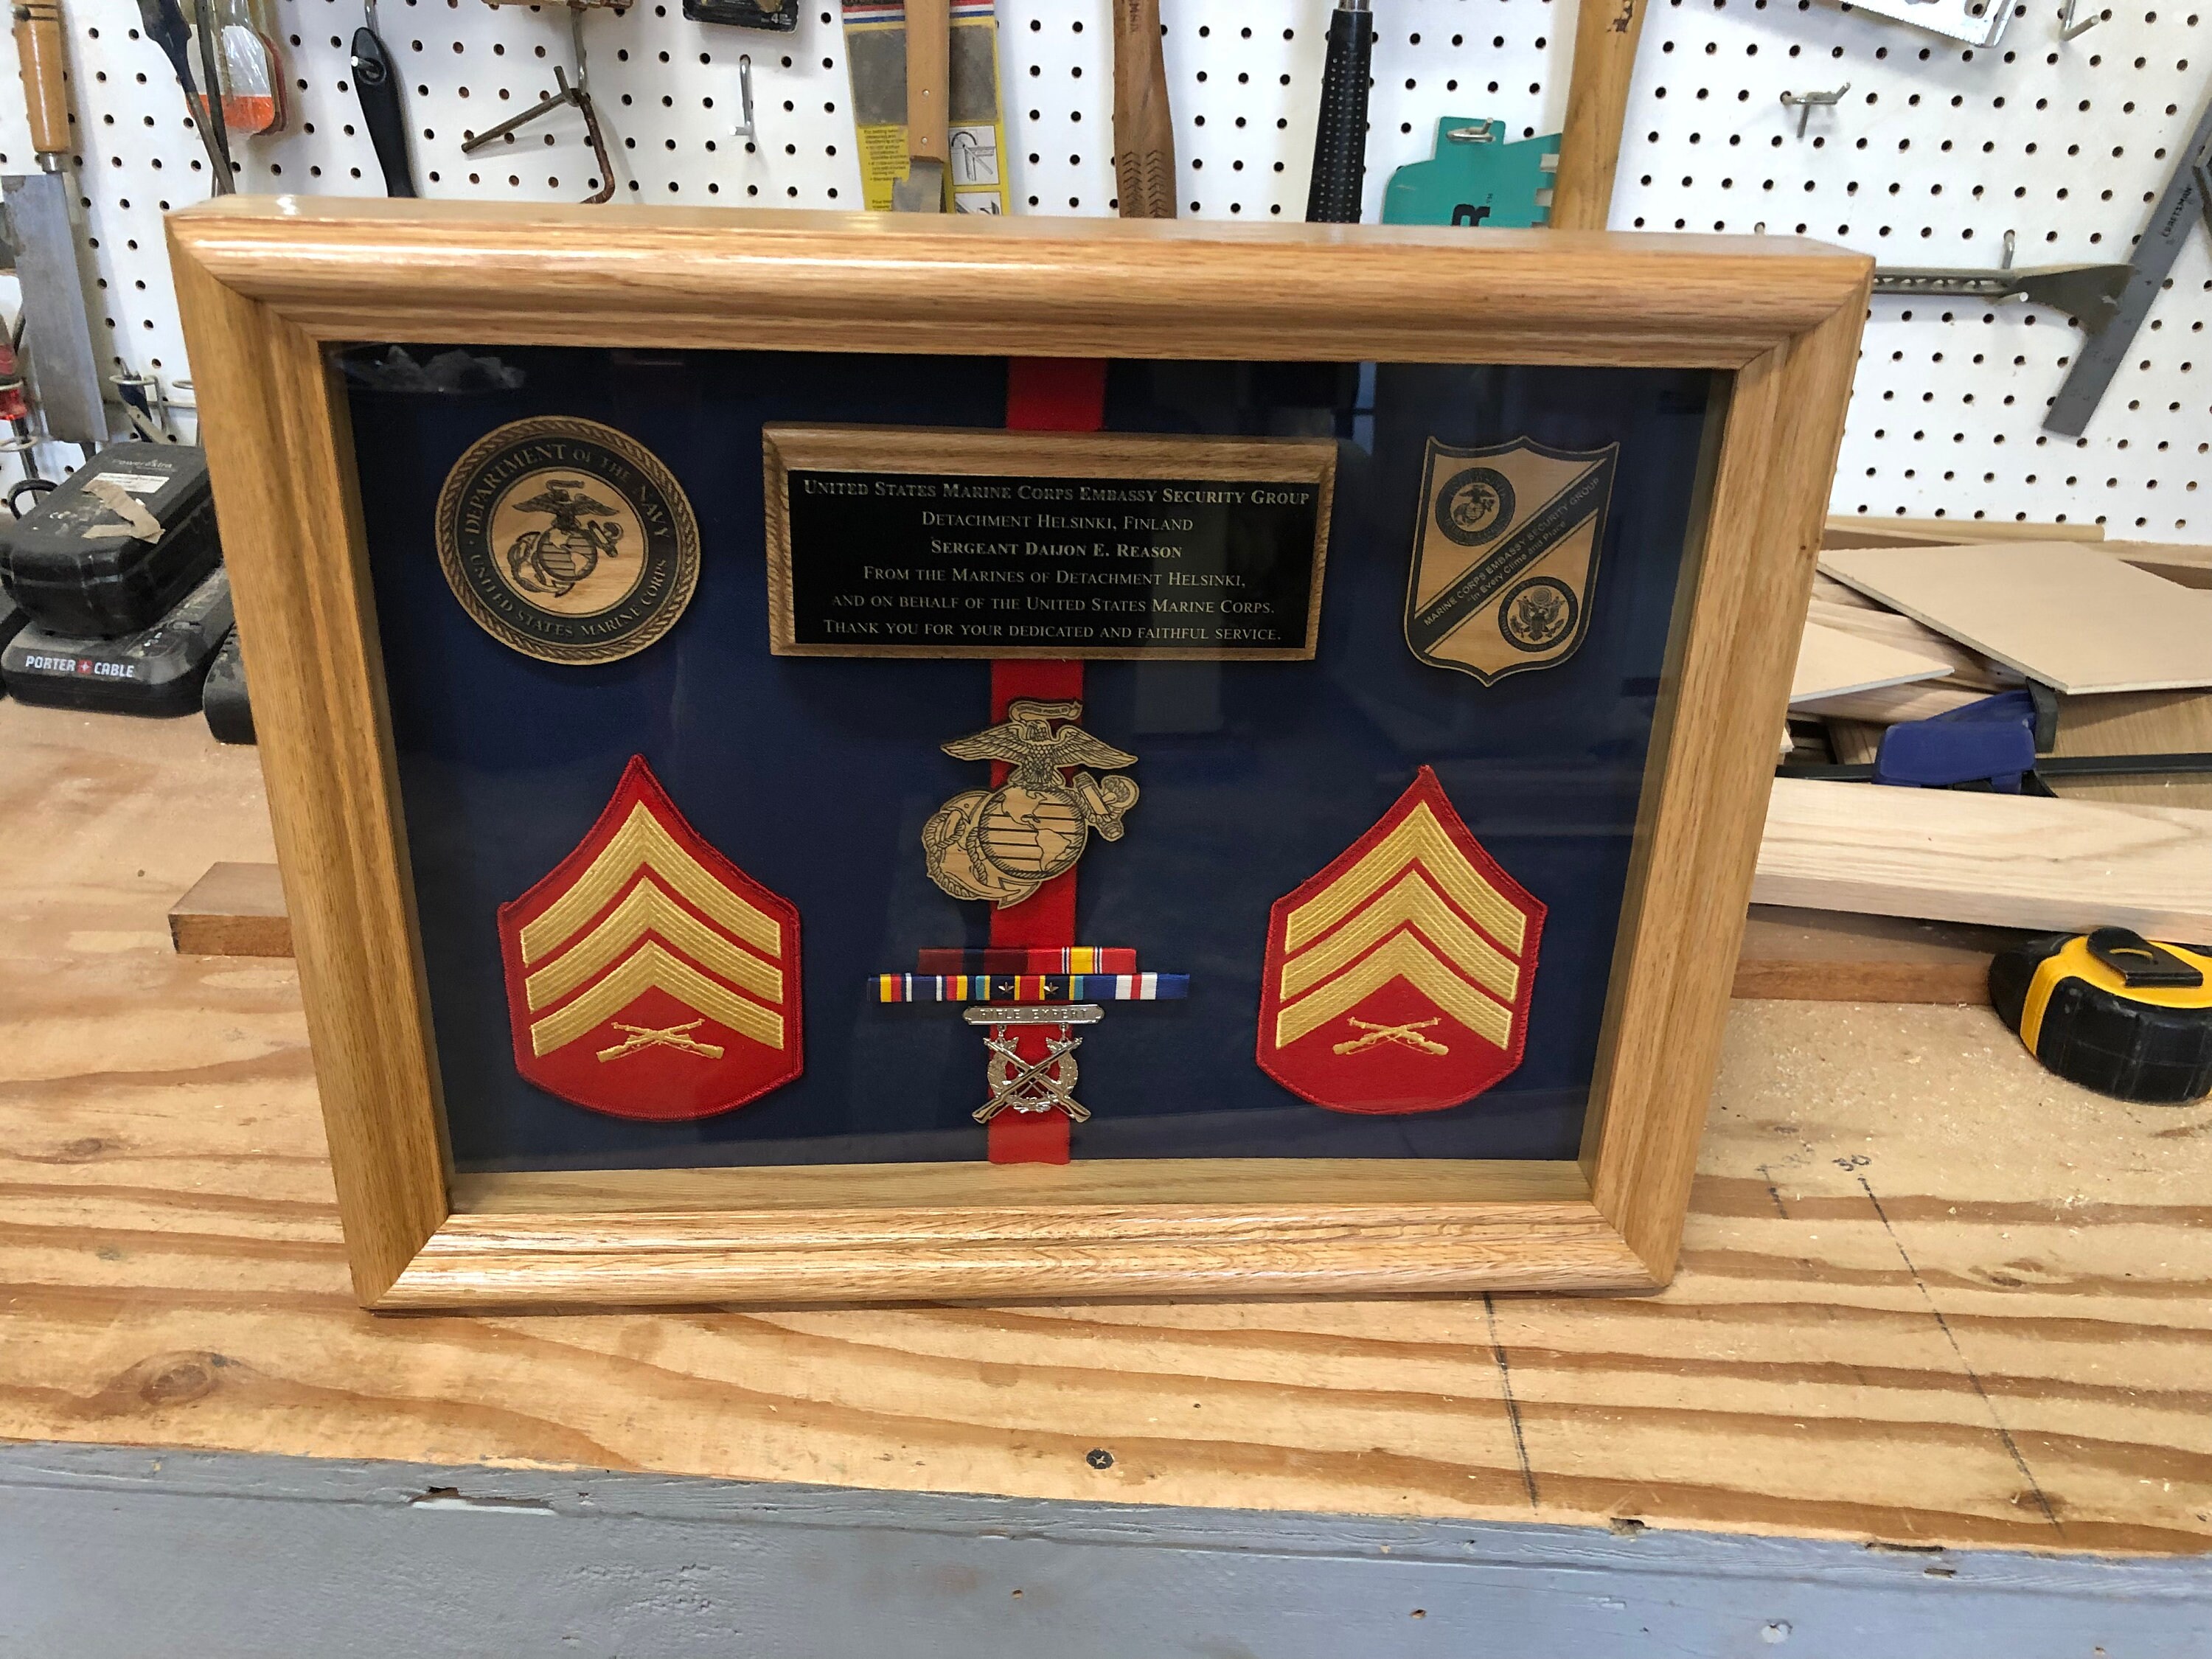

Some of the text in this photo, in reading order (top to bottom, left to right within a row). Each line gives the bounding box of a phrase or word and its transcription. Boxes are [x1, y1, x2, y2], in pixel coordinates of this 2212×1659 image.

[465, 444, 566, 534] DEPARTMENT
[601, 457, 630, 479] THE
[634, 484, 670, 538] NAVY
[804, 479, 1310, 505] UNITED STATES MARINE CORPS EMBASSY SECURITY GROUP
[922, 510, 1194, 531] DETACHMENT HELSINKI, FINLAND
[931, 539, 1182, 558] SERGEANT DAIJON E. REASON
[1424, 477, 1599, 626] MARINE CORPS EMBASSY SECURITY GROUP
[863, 566, 1245, 588] FROM THE MARINES OF DETACHMENT HELSINKI,
[1479, 573, 1503, 594] Every
[1503, 554, 1528, 574] Clime
[1528, 539, 1545, 555] and
[470, 554, 667, 636] UNITED STATES MARINE CORPS
[832, 595, 1276, 613] AND ON BEHALF OF THE UNITED STATES MARINE CORPS.
[823, 619, 1281, 641] THANK YOU FOR YOUR DEDICATED AND FAITHFUL SERVICE.
[25, 655, 135, 678] PORTER CABLE
[979, 1007, 1088, 1020] RIFLE EXPERT
